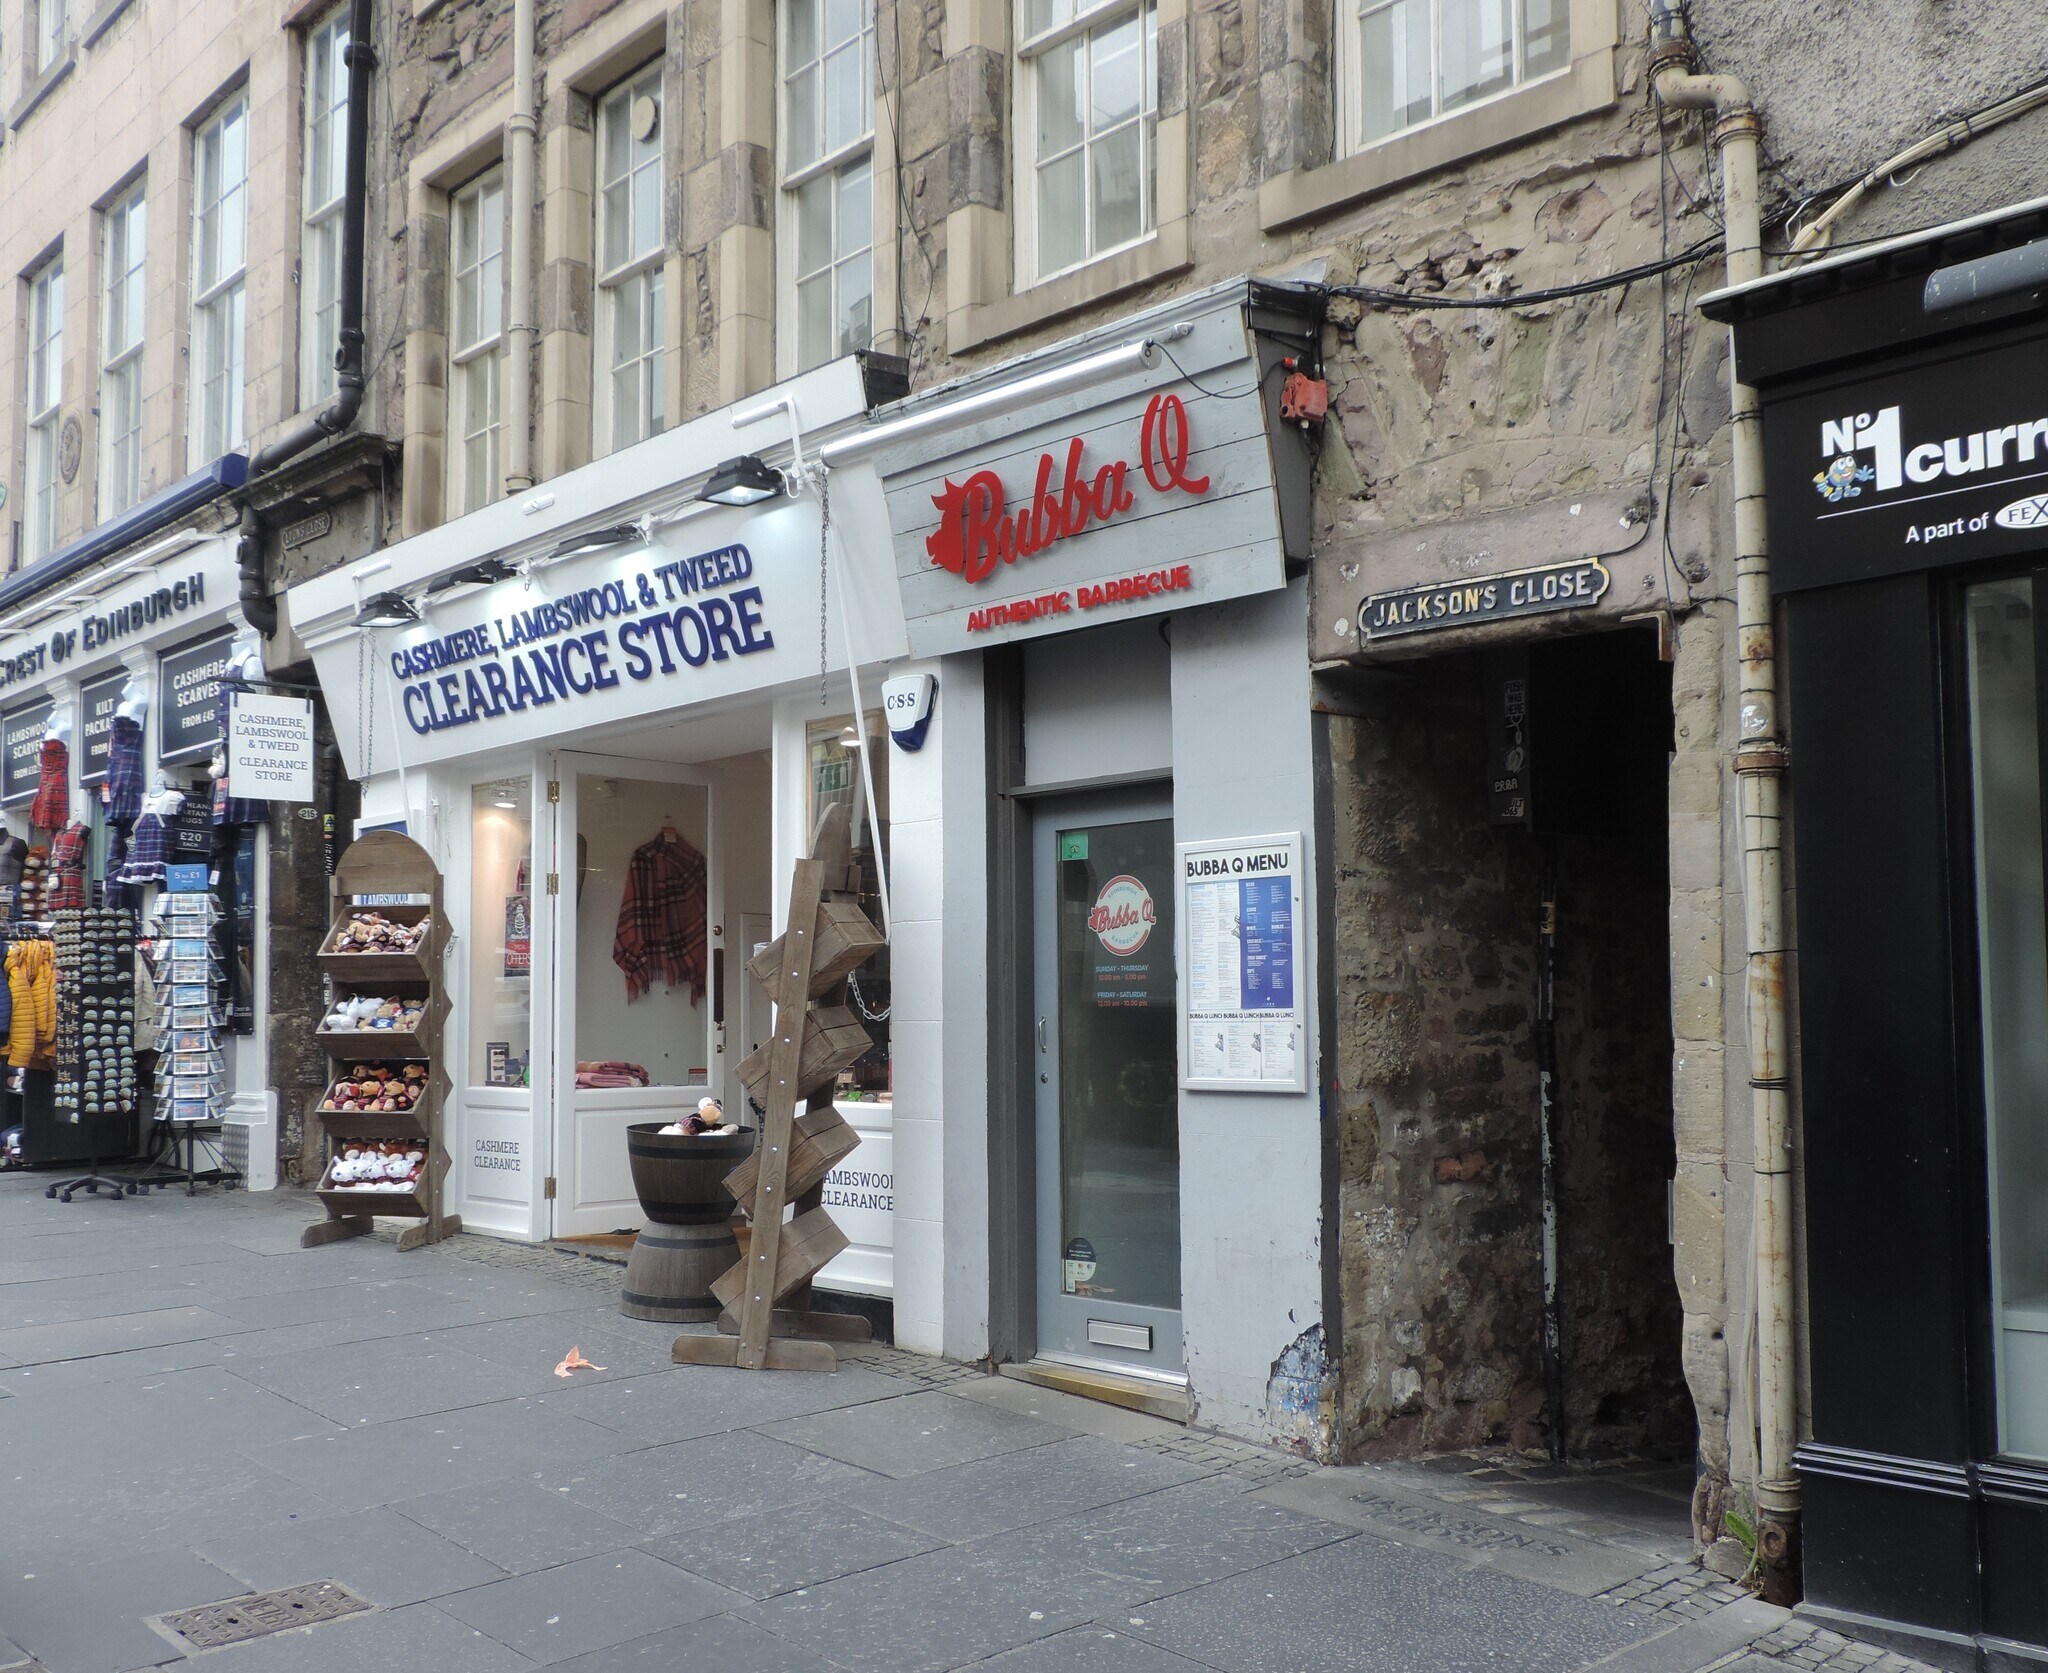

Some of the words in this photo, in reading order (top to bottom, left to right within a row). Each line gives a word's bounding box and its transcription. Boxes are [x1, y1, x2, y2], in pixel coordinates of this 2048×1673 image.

[1905, 417, 2048, 483] curr
[959, 437, 1133, 584] Bubba
[1140, 394, 1210, 494] Q
[1905, 525, 1920, 544] A
[1924, 517, 1965, 544] part
[1968, 511, 1989, 532] of
[967, 591, 1070, 632] AUTHENTIC
[1077, 565, 1191, 609] BARBECUE
[1373, 584, 1497, 627] JACKSON'S
[1510, 570, 1592, 606] CLOSE
[51, 628, 77, 663] OF
[82, 572, 206, 651] EDINBURGH
[391, 622, 499, 680] CASHMERE,
[500, 578, 637, 646] LAMBSWOOL
[636, 573, 656, 608] &
[654, 543, 753, 600] TWEED
[402, 628, 620, 736] CLEARANCE
[618, 585, 775, 681] STORE
[173, 659, 226, 690] CASHMERE
[177, 681, 221, 708] SCARVES
[95, 698, 115, 717] KILT
[182, 713, 202, 729] FROM
[239, 713, 305, 729] CASHMERE,
[7, 721, 48, 746] LAMBSWOO
[235, 726, 309, 741] LAMBSWOOL
[91, 743, 108, 756] FROM
[248, 739, 256, 749] &
[258, 740, 299, 752] TWEED
[239, 757, 308, 770] CLEARANCE
[255, 770, 293, 782] STORE
[301, 809, 315, 818] 215
[179, 831, 202, 842] £20
[1187, 858, 1230, 877] BUBBA
[1231, 857, 1244, 873] Q
[1246, 852, 1288, 872] MENU
[1107, 886, 1138, 899] EDINBURGH
[1096, 903, 1140, 934] Bubba
[1142, 898, 1156, 923] Q
[1111, 930, 1140, 945] BARBECUE
[1095, 965, 1116, 973] SUNDAY
[1120, 964, 1149, 972] THURSDAY
[475, 1139, 519, 1154] CASHMERE
[474, 1155, 521, 1171] CLEARANCE
[823, 1170, 893, 1189] AMBSWOO
